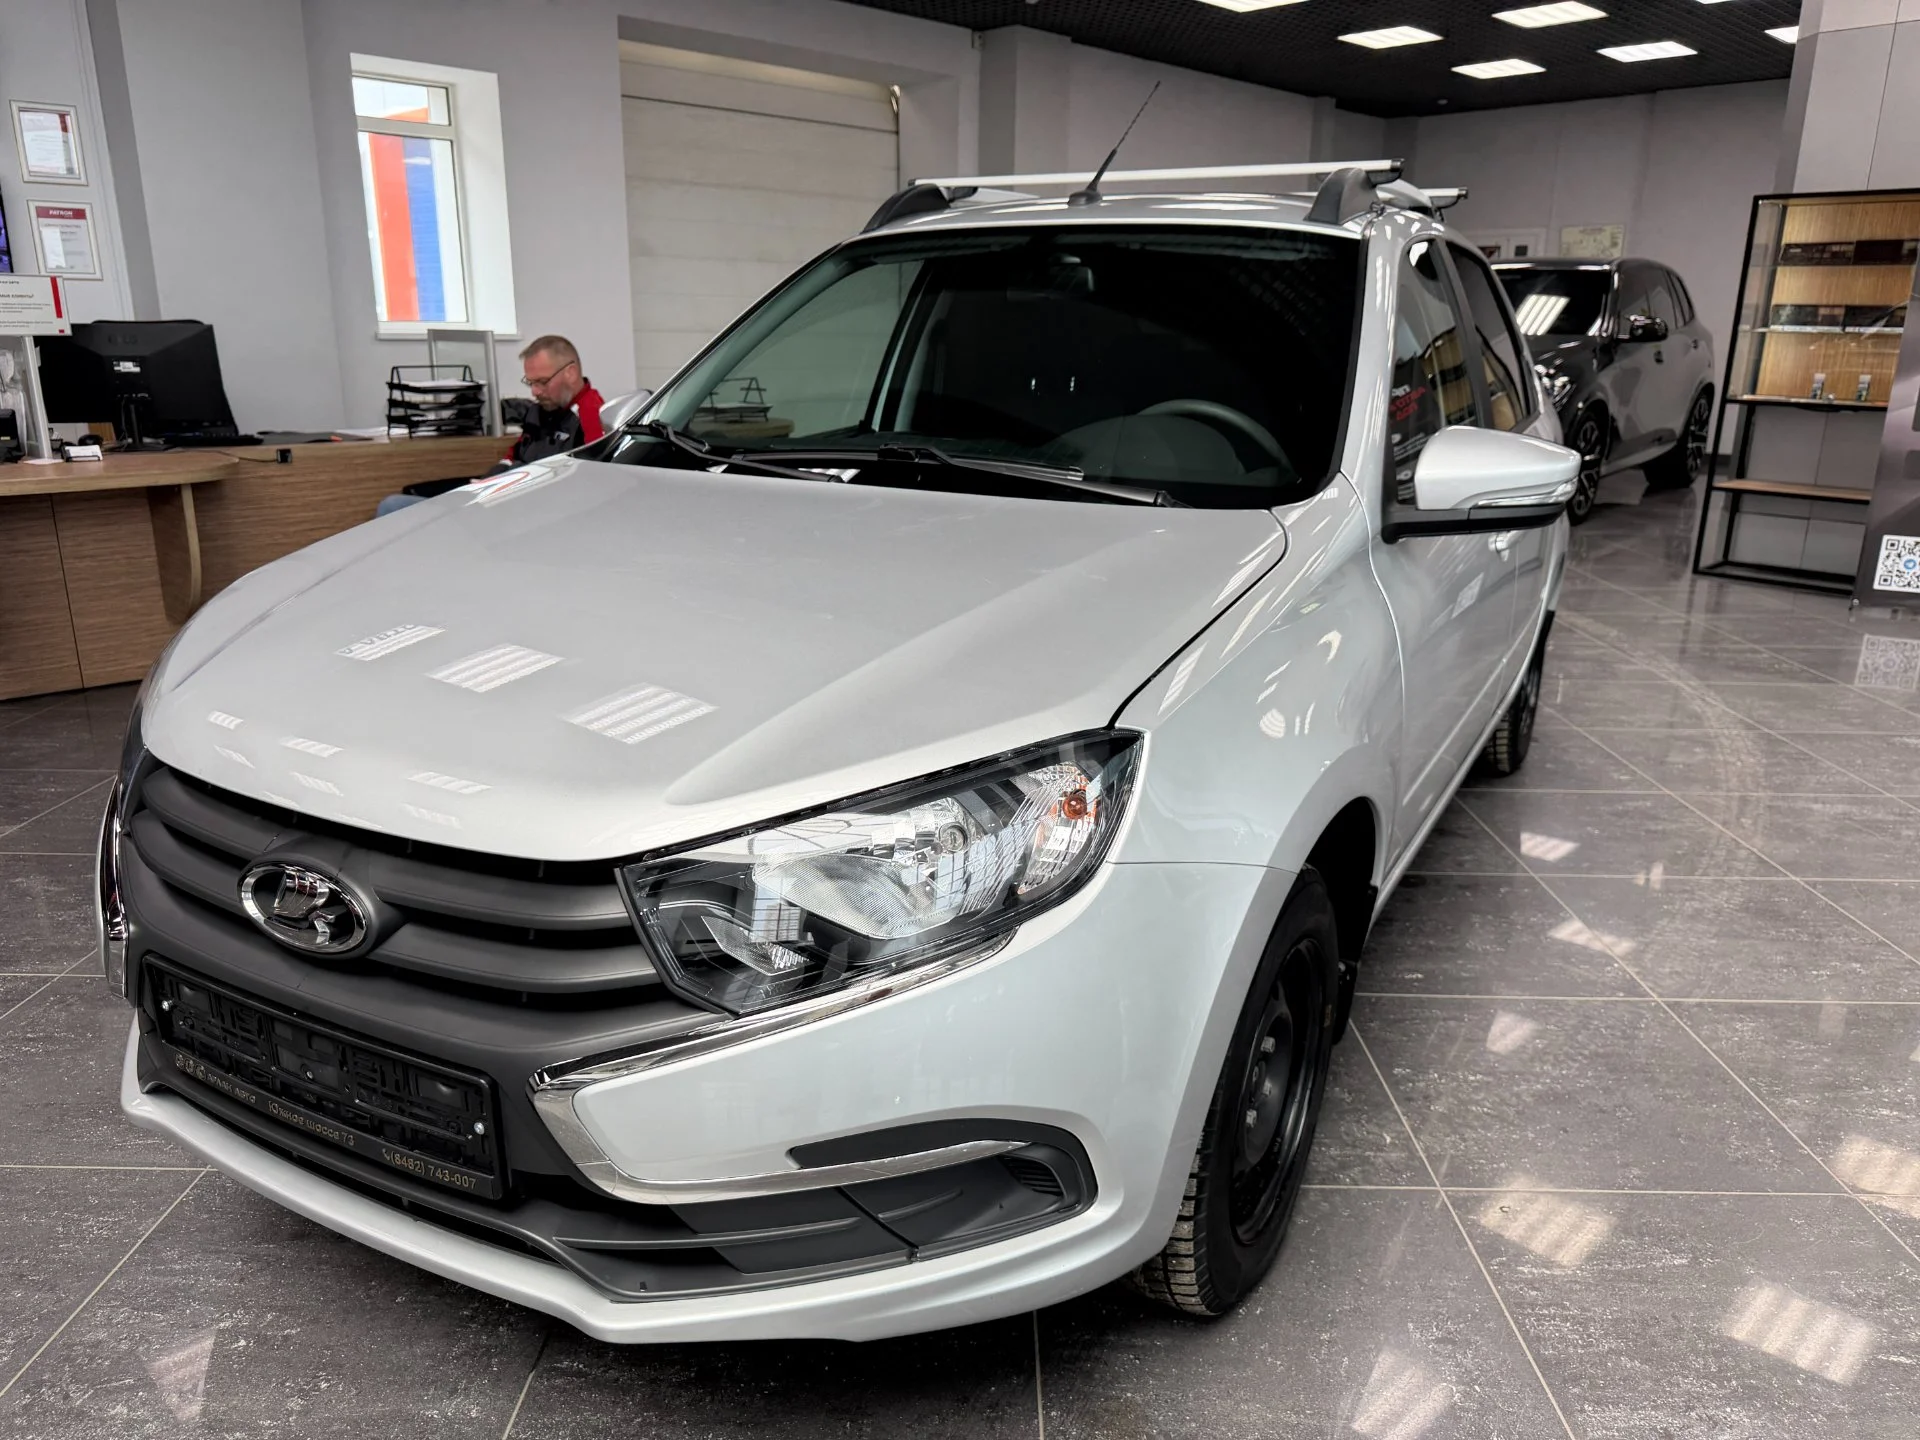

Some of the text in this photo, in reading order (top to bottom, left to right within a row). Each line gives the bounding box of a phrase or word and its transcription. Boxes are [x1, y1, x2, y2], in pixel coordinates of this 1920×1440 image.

[267, 1100, 355, 1147] Южное шоссе 73
[390, 1150, 477, 1190] (8482) 743-007
